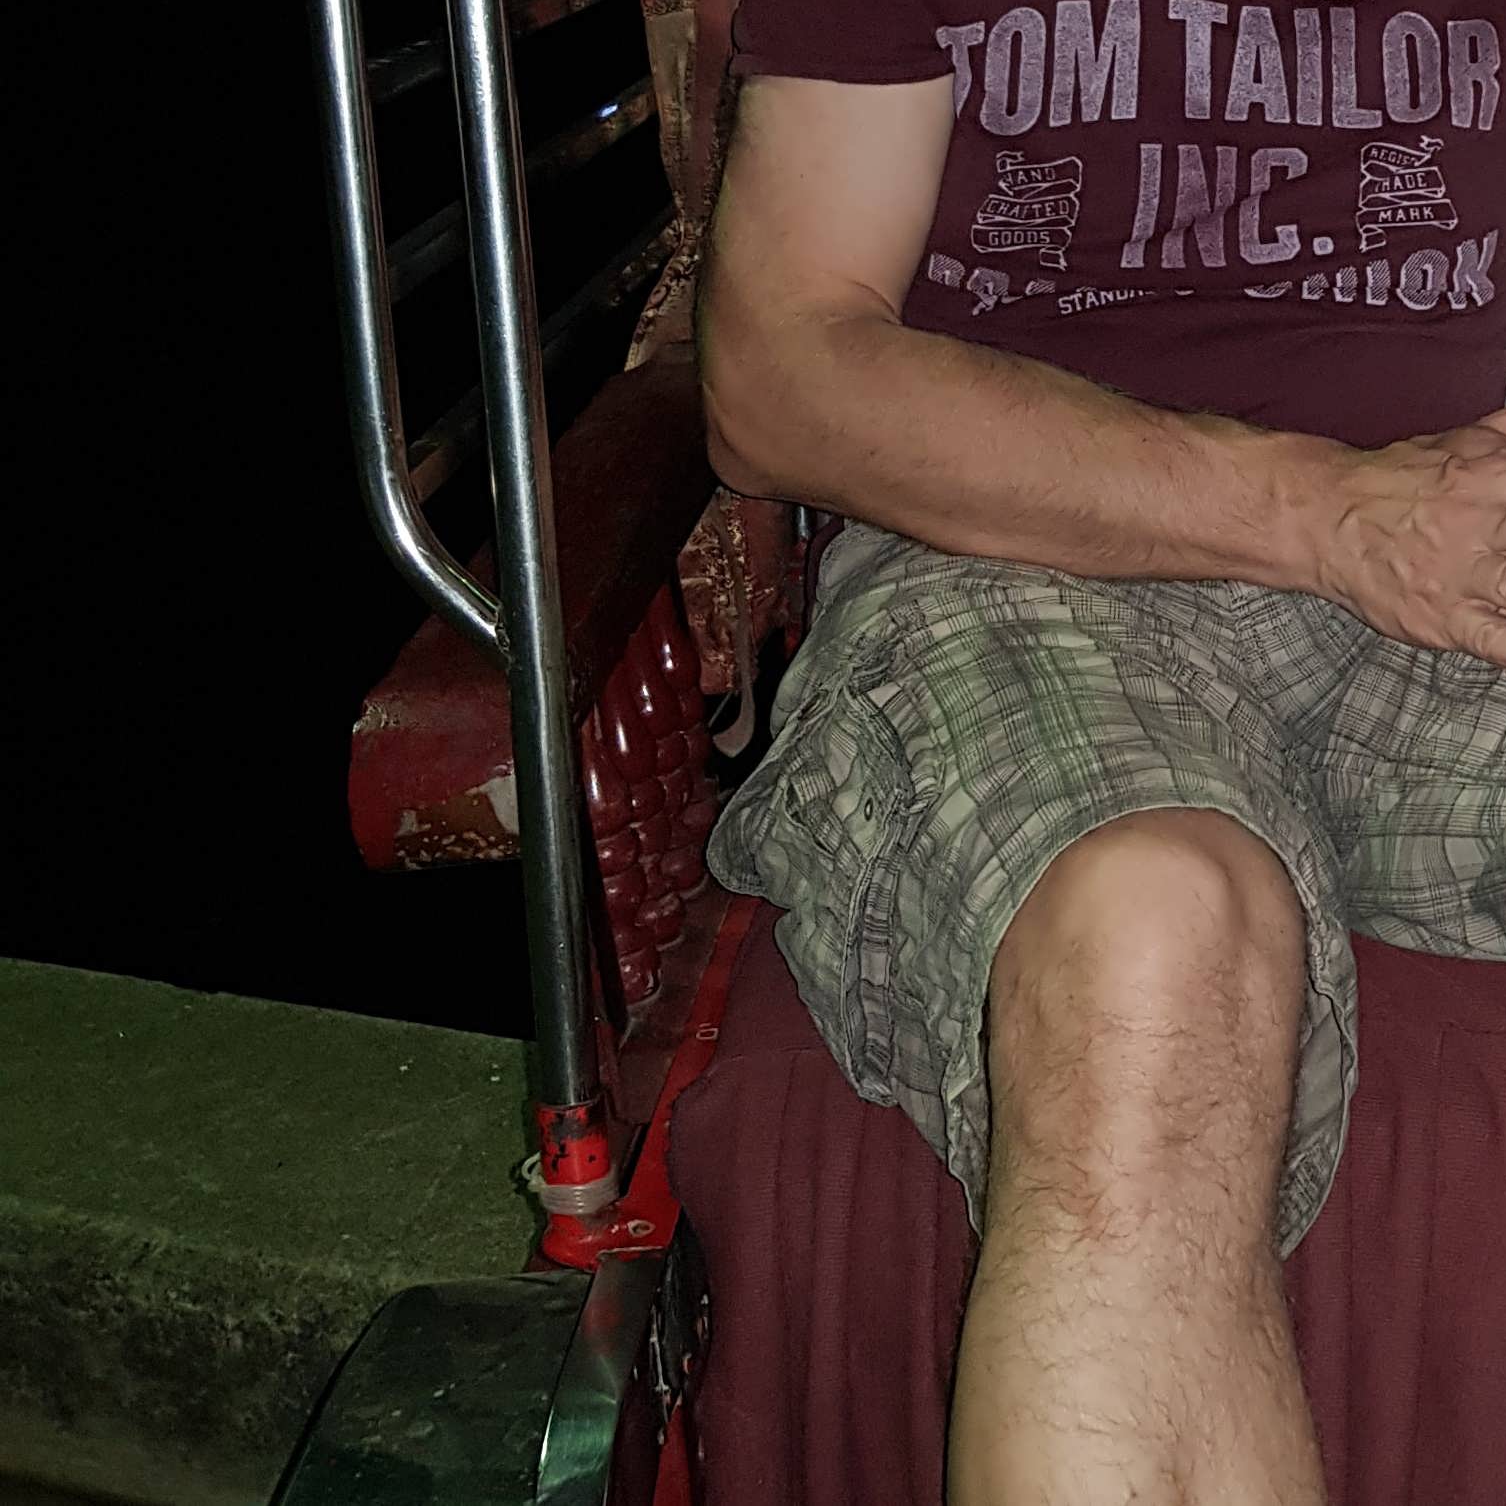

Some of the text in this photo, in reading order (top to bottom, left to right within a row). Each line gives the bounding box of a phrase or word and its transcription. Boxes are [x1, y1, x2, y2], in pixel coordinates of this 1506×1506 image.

[1120, 143, 1335, 270] INC.
[1378, 206, 1435, 223] MARK
[988, 230, 1051, 246] GOODS
